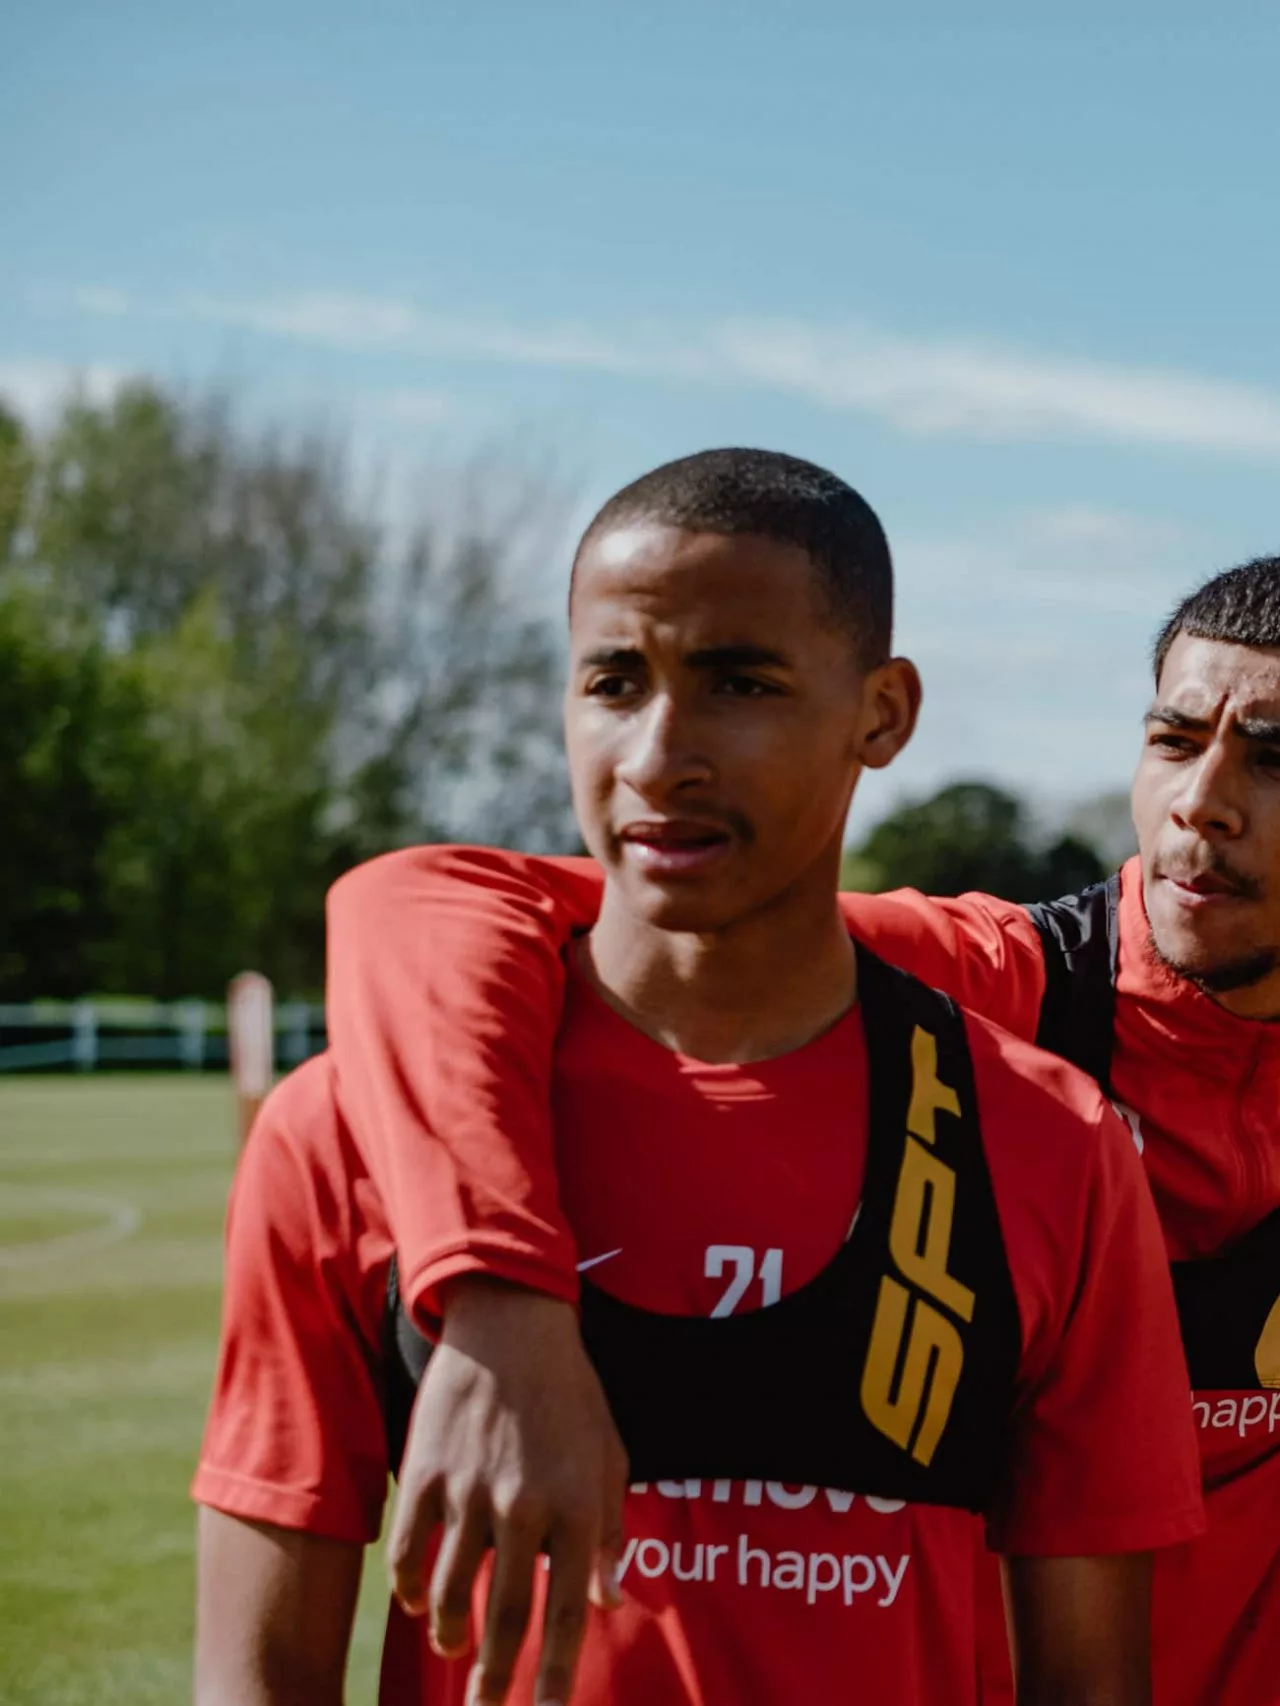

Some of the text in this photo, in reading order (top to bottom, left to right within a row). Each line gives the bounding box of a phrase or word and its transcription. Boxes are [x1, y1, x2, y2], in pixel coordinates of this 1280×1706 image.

[704, 1244, 783, 1318] 21
[860, 1024, 976, 1468] SPT
[737, 1533, 910, 1607] happy
